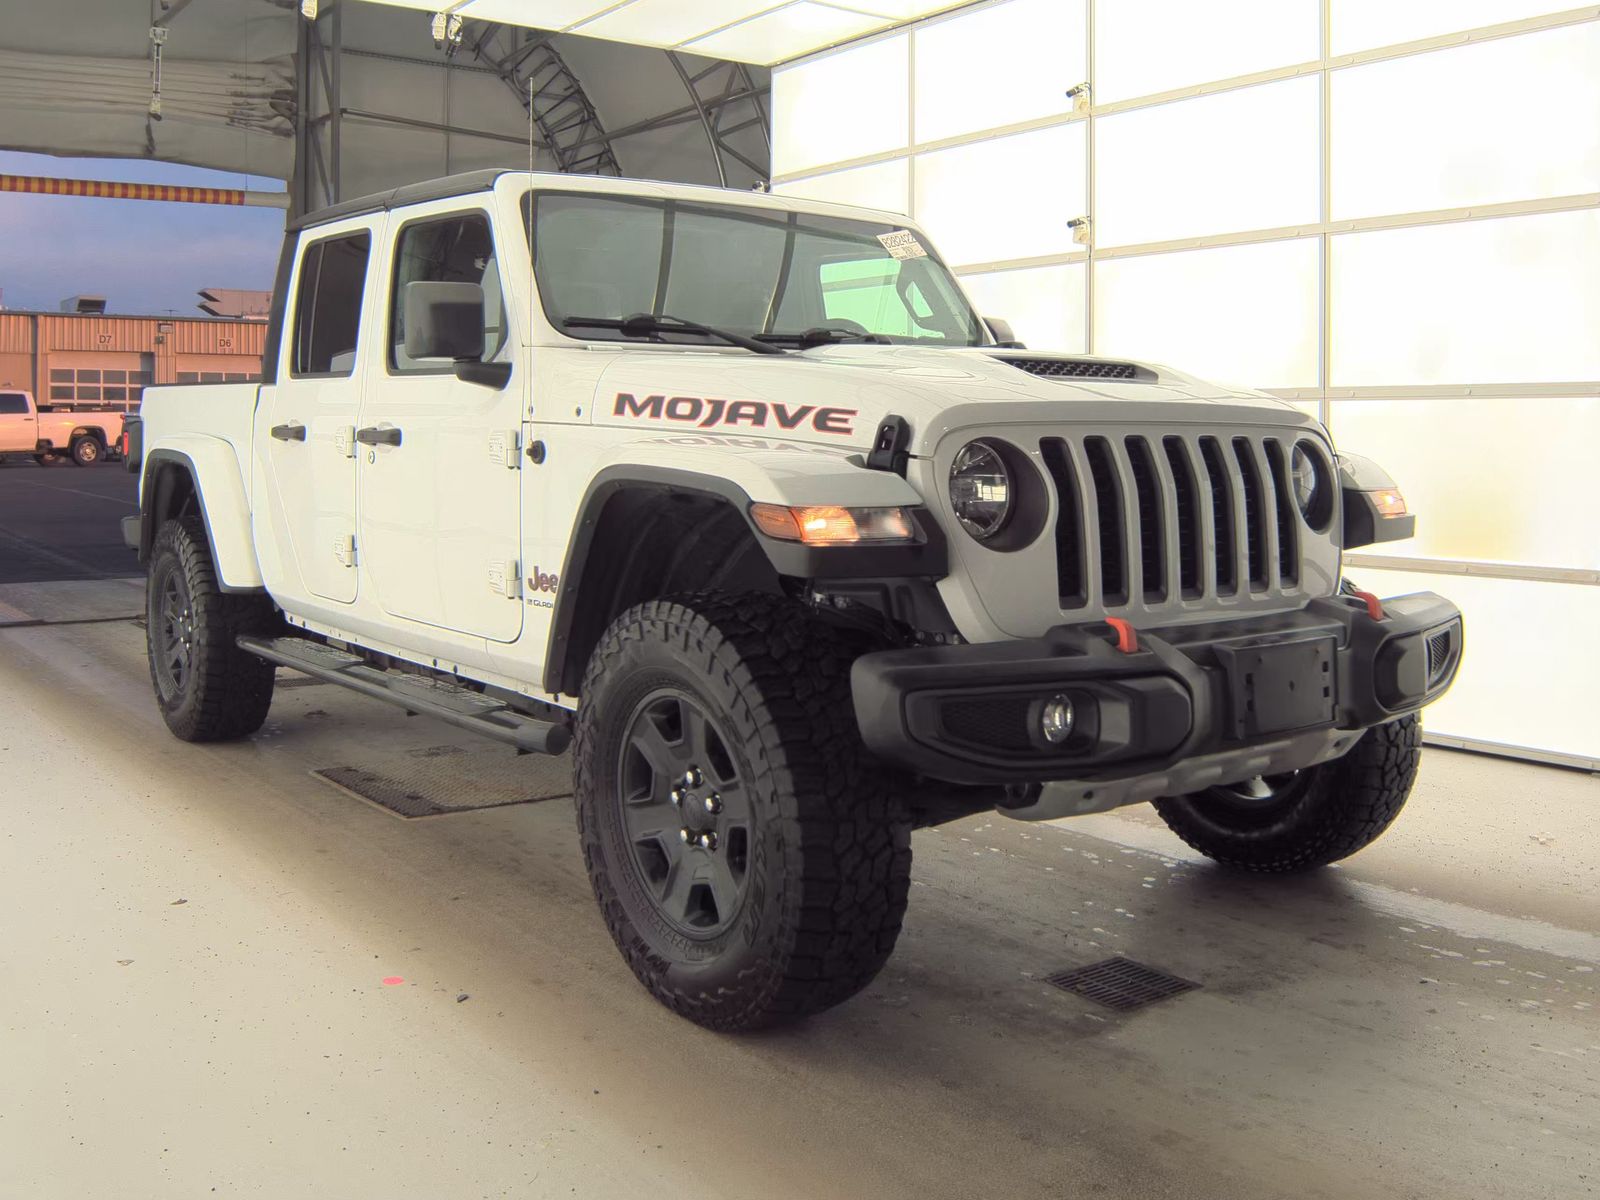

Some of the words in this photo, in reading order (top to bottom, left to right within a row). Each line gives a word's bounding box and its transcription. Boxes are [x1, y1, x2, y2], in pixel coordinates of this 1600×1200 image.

[99, 335, 112, 344] D7
[219, 339, 232, 347] D6
[612, 392, 858, 436] MOJAVE
[527, 565, 559, 594] Jee
